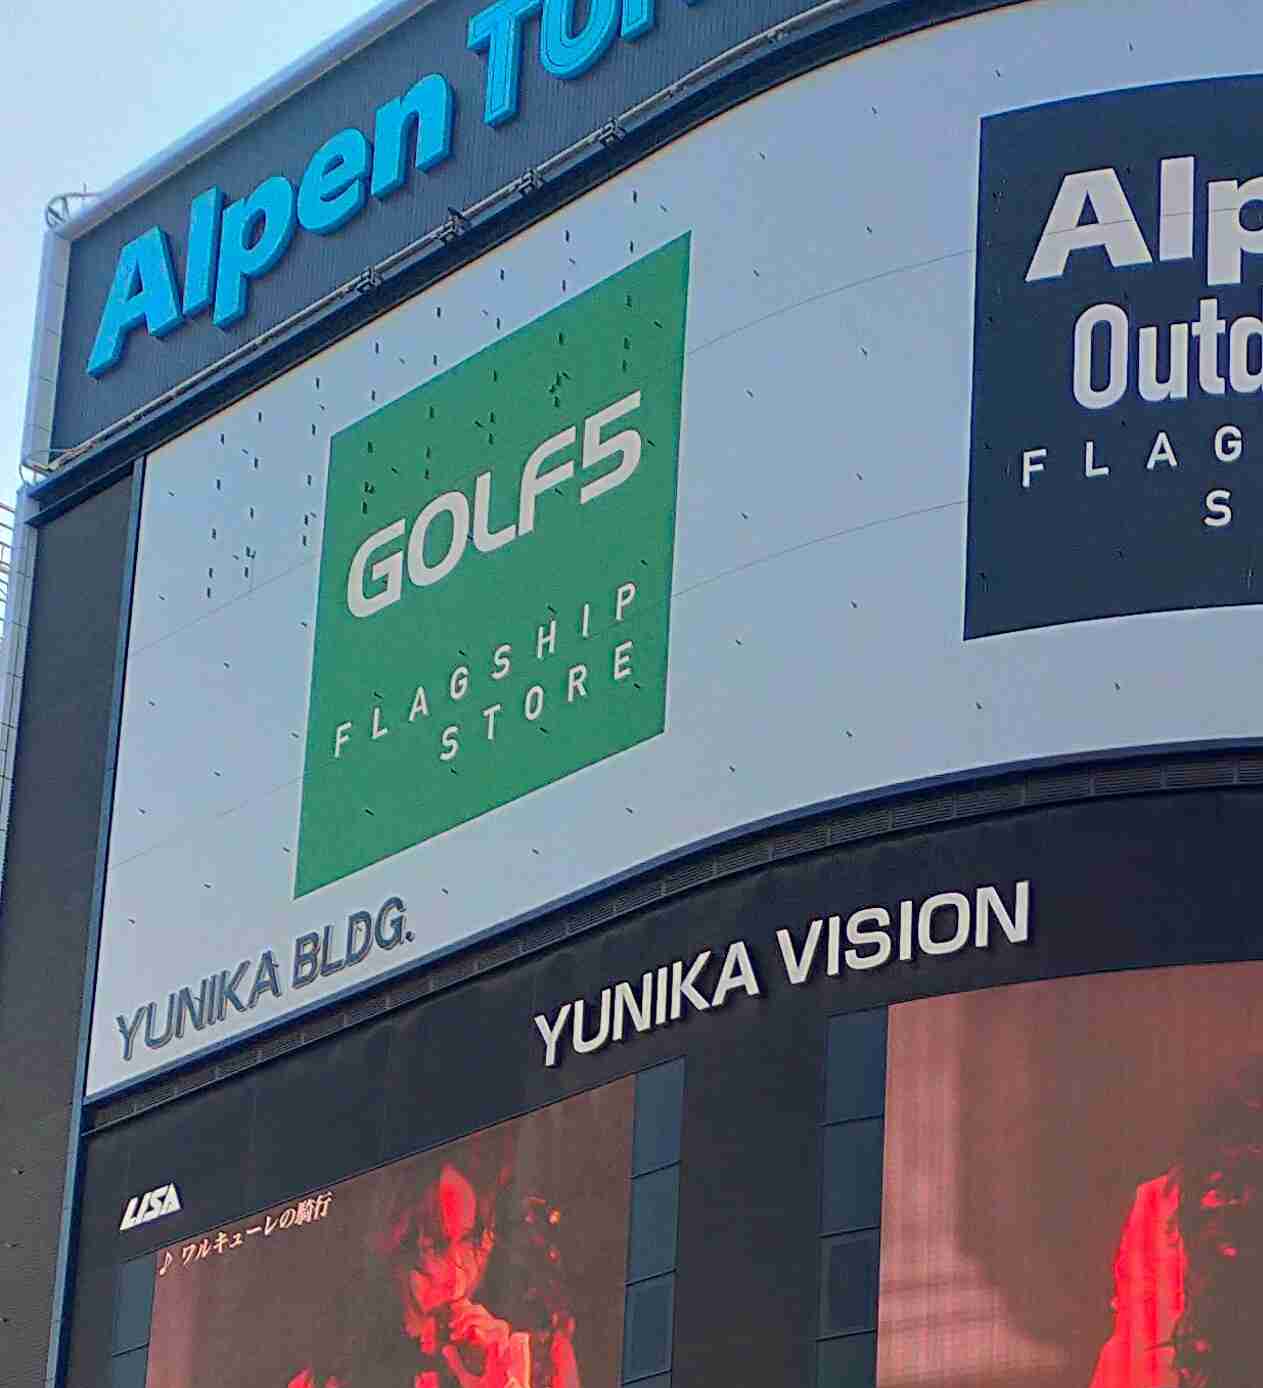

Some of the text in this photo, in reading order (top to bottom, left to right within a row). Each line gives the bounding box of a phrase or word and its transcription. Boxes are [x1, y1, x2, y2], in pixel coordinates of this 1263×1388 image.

[86, 72, 456, 378] Alpen
[347, 391, 642, 618] GOLF5
[333, 583, 637, 757] FLAGSHIP
[439, 641, 635, 762] STORE
[115, 896, 416, 1064] YUNIKA BLDG.
[534, 880, 1032, 1069] YUNIKA VISION
